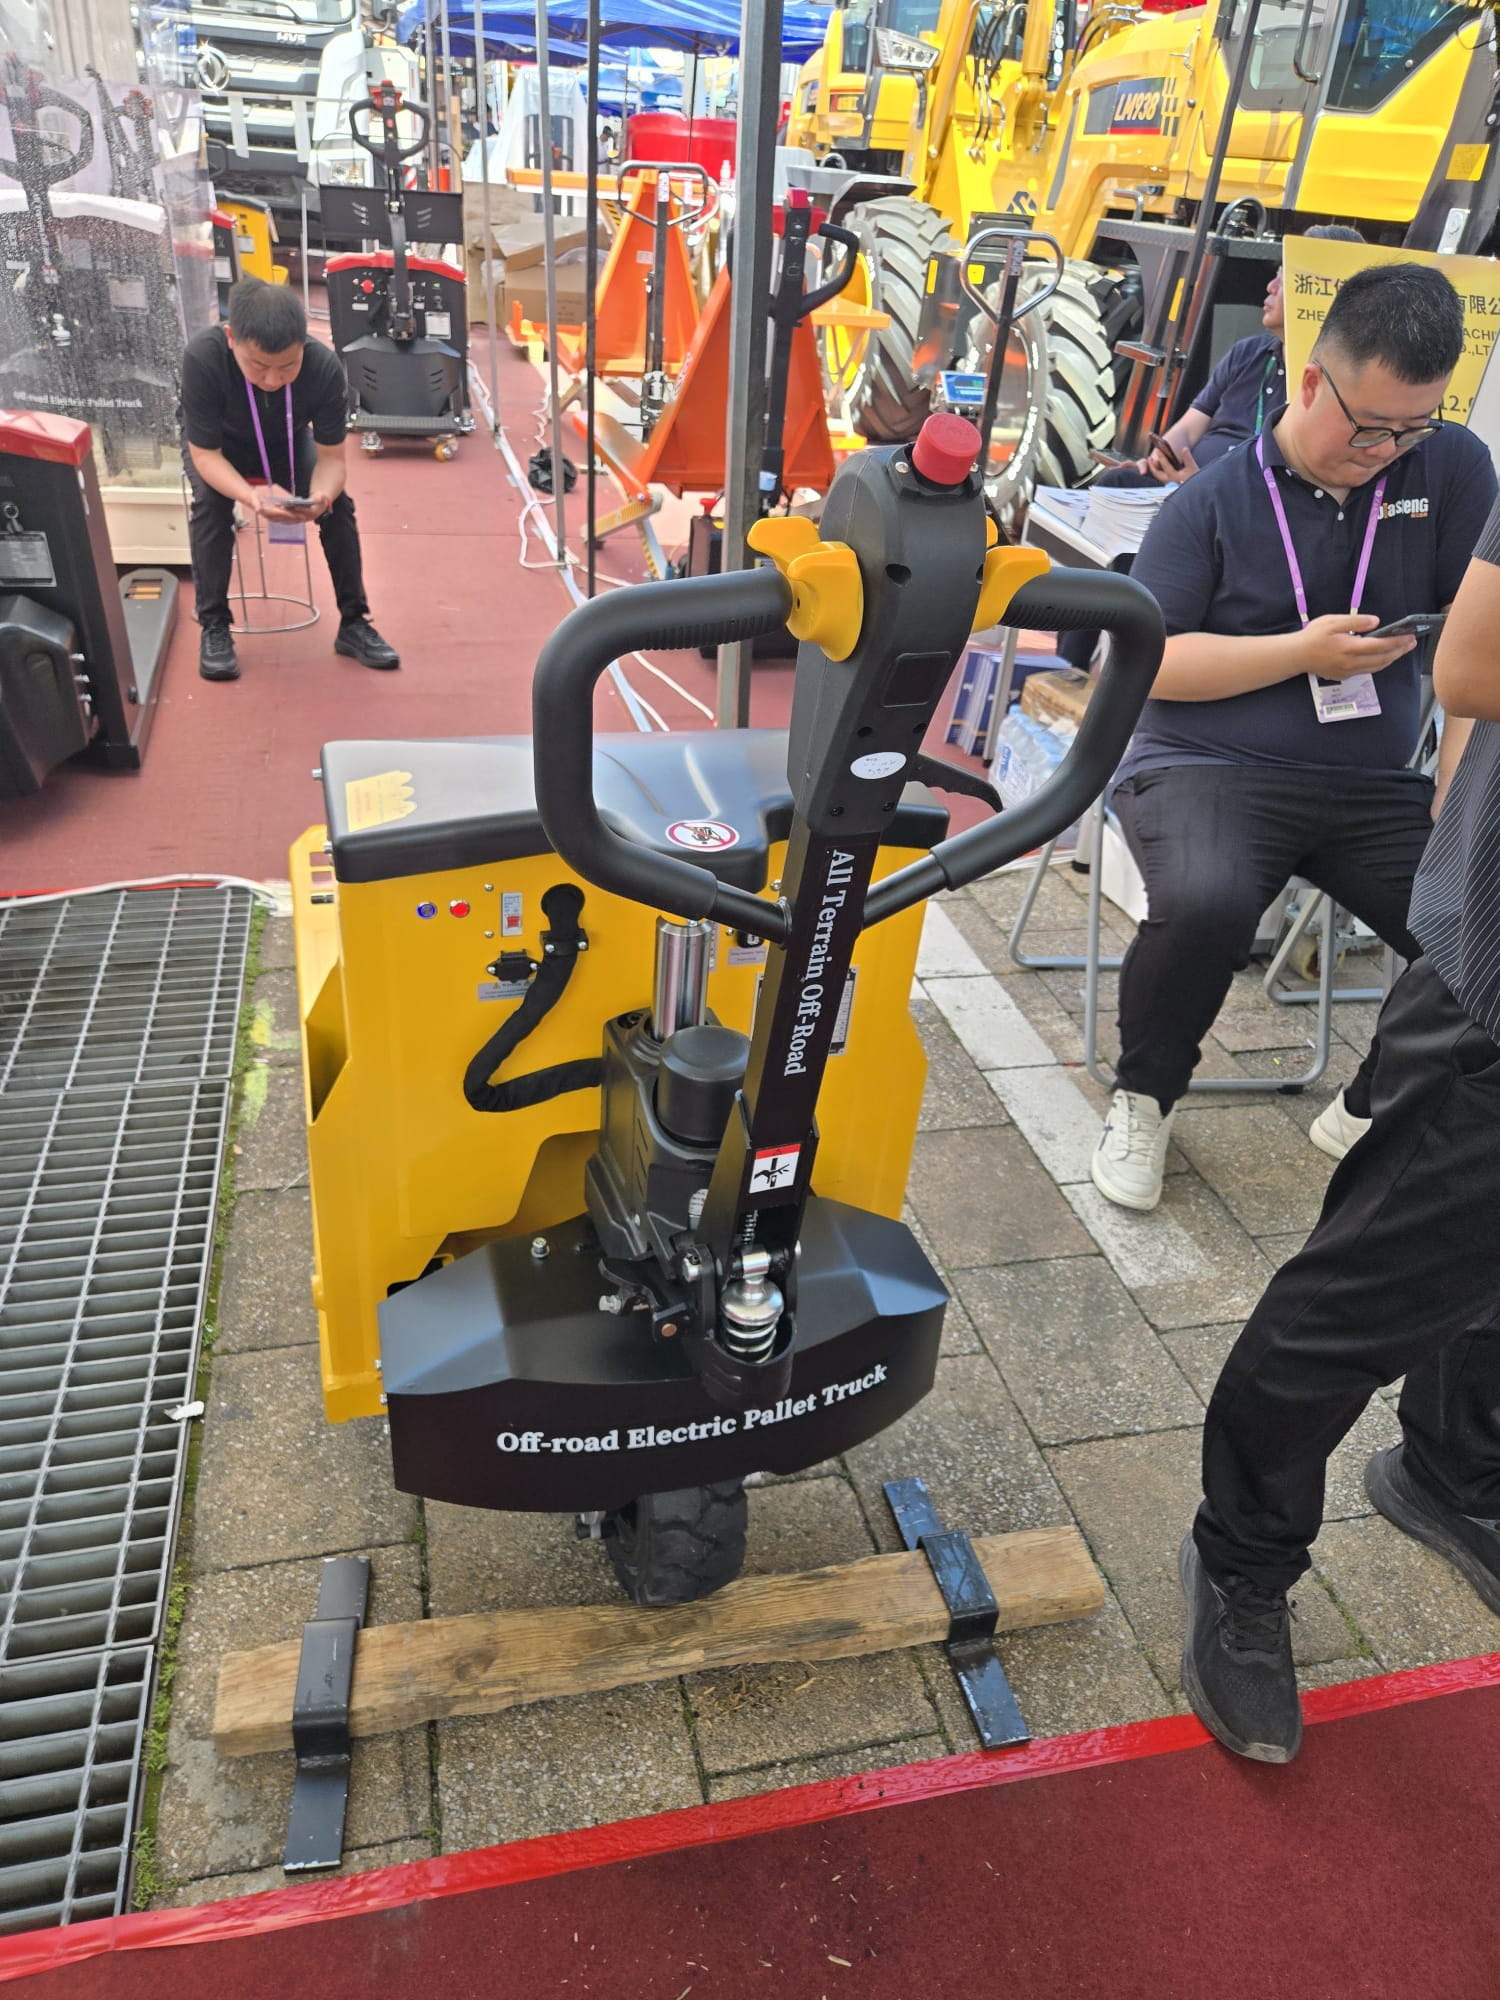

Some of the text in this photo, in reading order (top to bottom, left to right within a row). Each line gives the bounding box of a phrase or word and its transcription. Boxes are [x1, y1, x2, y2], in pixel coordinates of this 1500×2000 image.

[1113, 91, 1161, 121] LM938
[1294, 274, 1346, 296] 浙江
[1463, 327, 1498, 342] ACHI
[826, 849, 855, 886] All
[805, 889, 847, 980] Terrain
[784, 983, 824, 1077] Off-Road
[496, 1363, 888, 1454] Off-road Electric Pallet Truck
